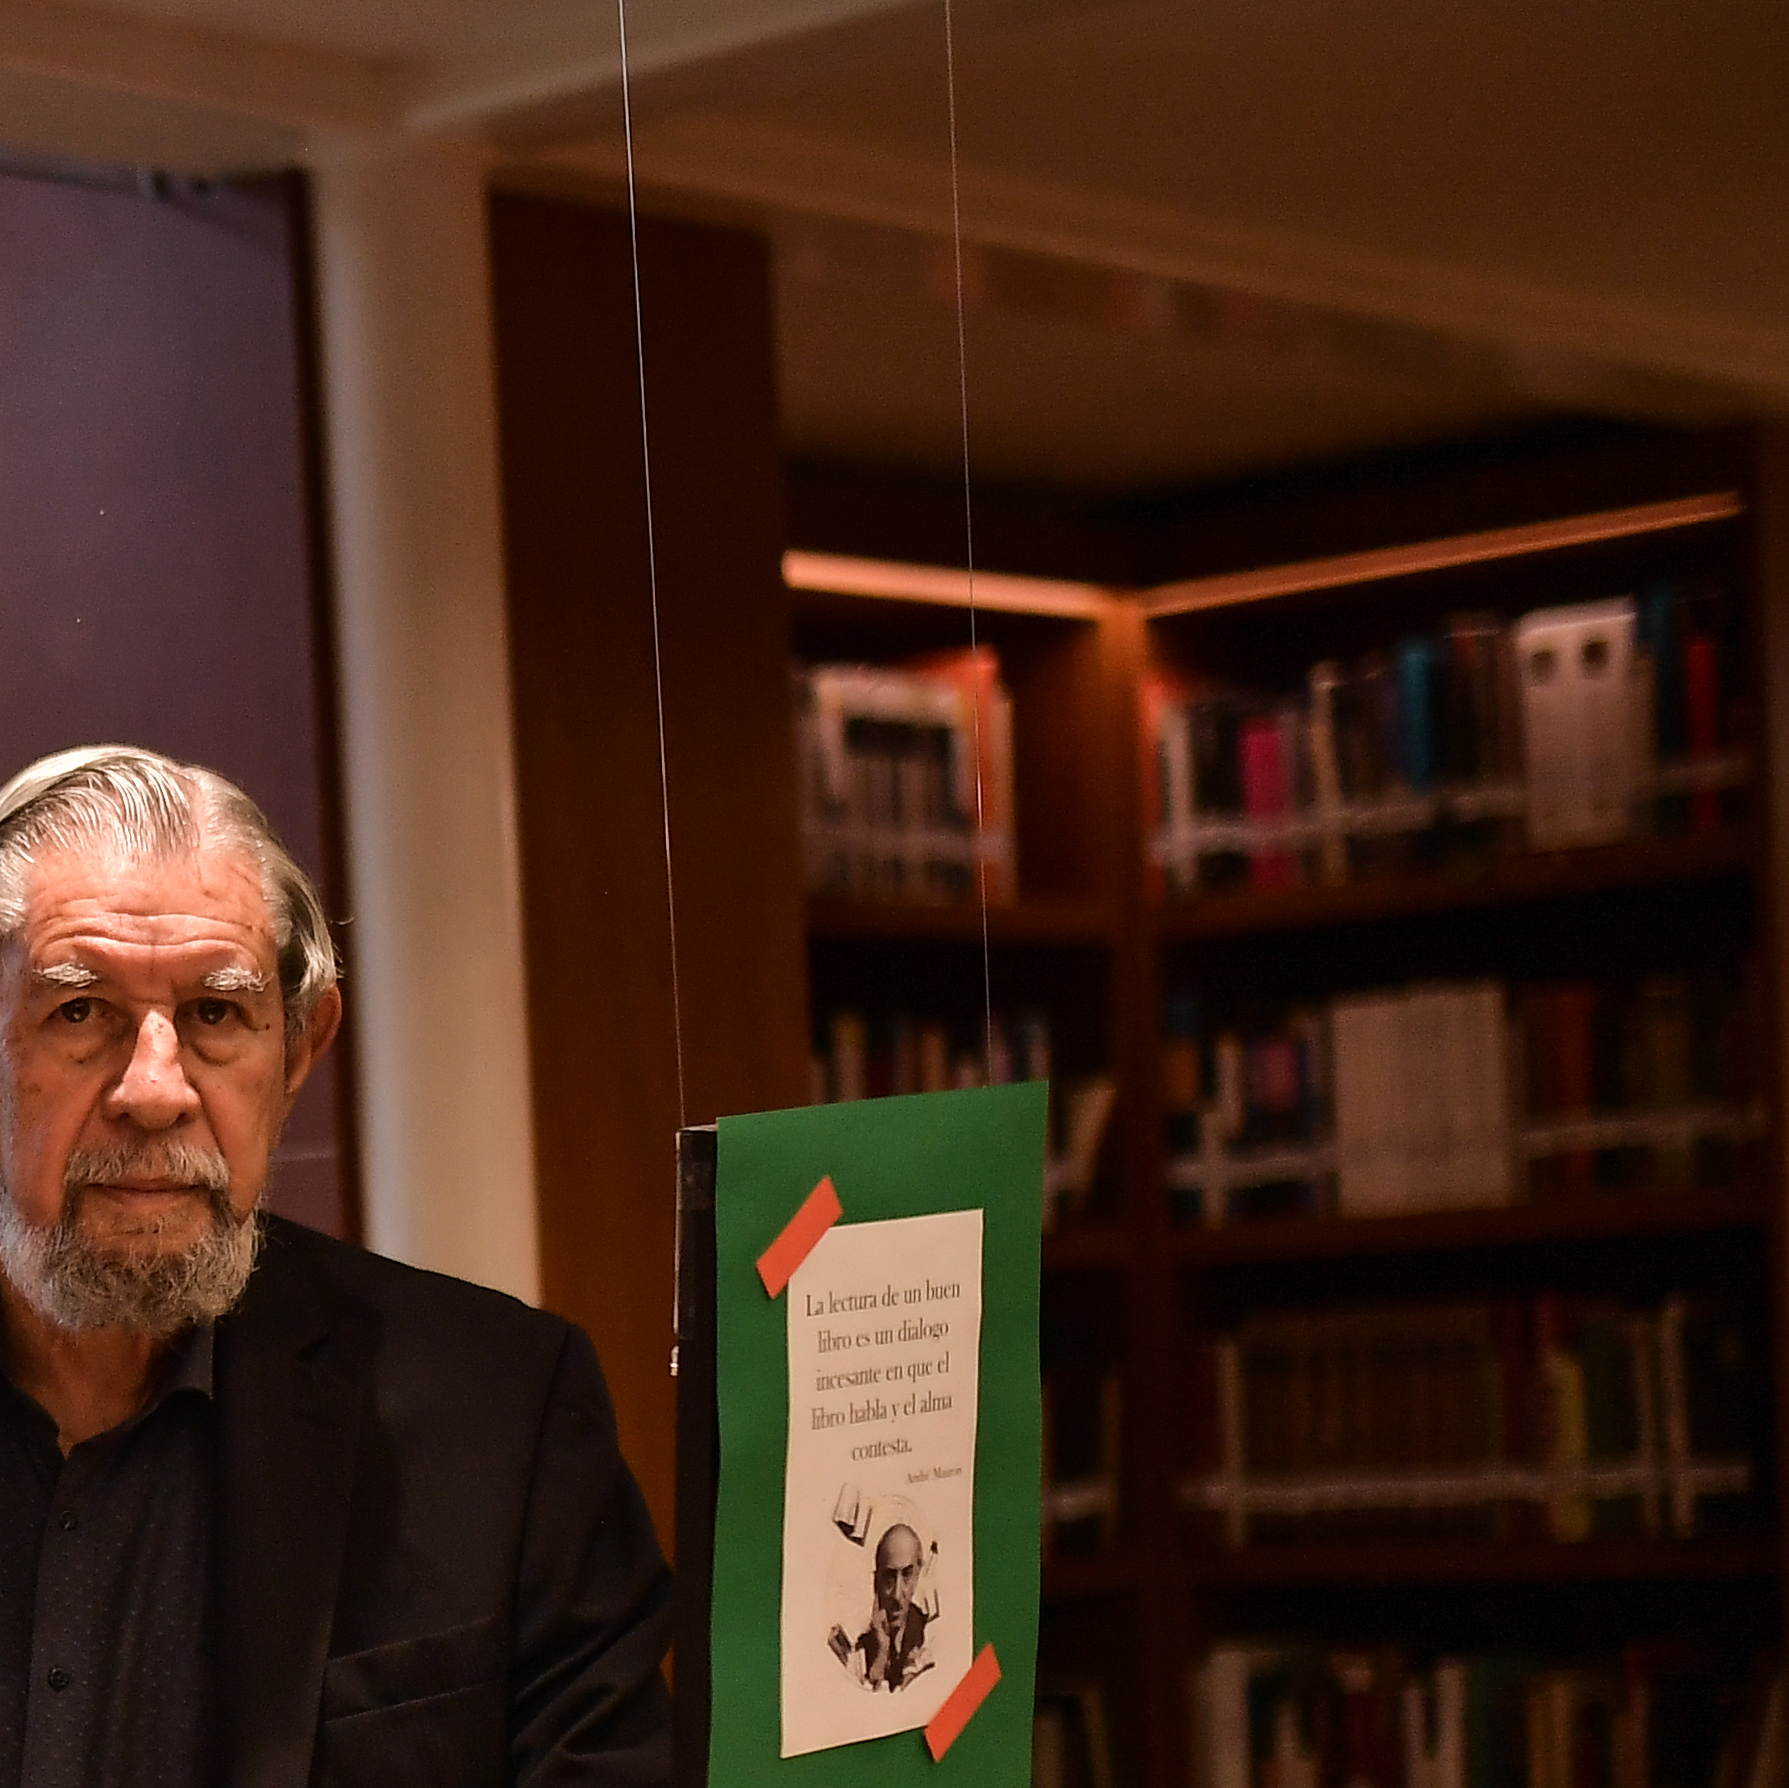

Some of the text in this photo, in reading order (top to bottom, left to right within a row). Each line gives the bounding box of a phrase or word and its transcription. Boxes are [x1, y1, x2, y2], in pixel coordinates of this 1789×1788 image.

[806, 1279, 960, 1317] La lectura de un buen
[818, 1330, 852, 1353] libro
[856, 1333, 870, 1348] es
[875, 1330, 893, 1345] un
[816, 1351, 950, 1391] incesante en que el
[811, 1390, 953, 1430] libro habla y el alma
[852, 1438, 913, 1461] contesta.
